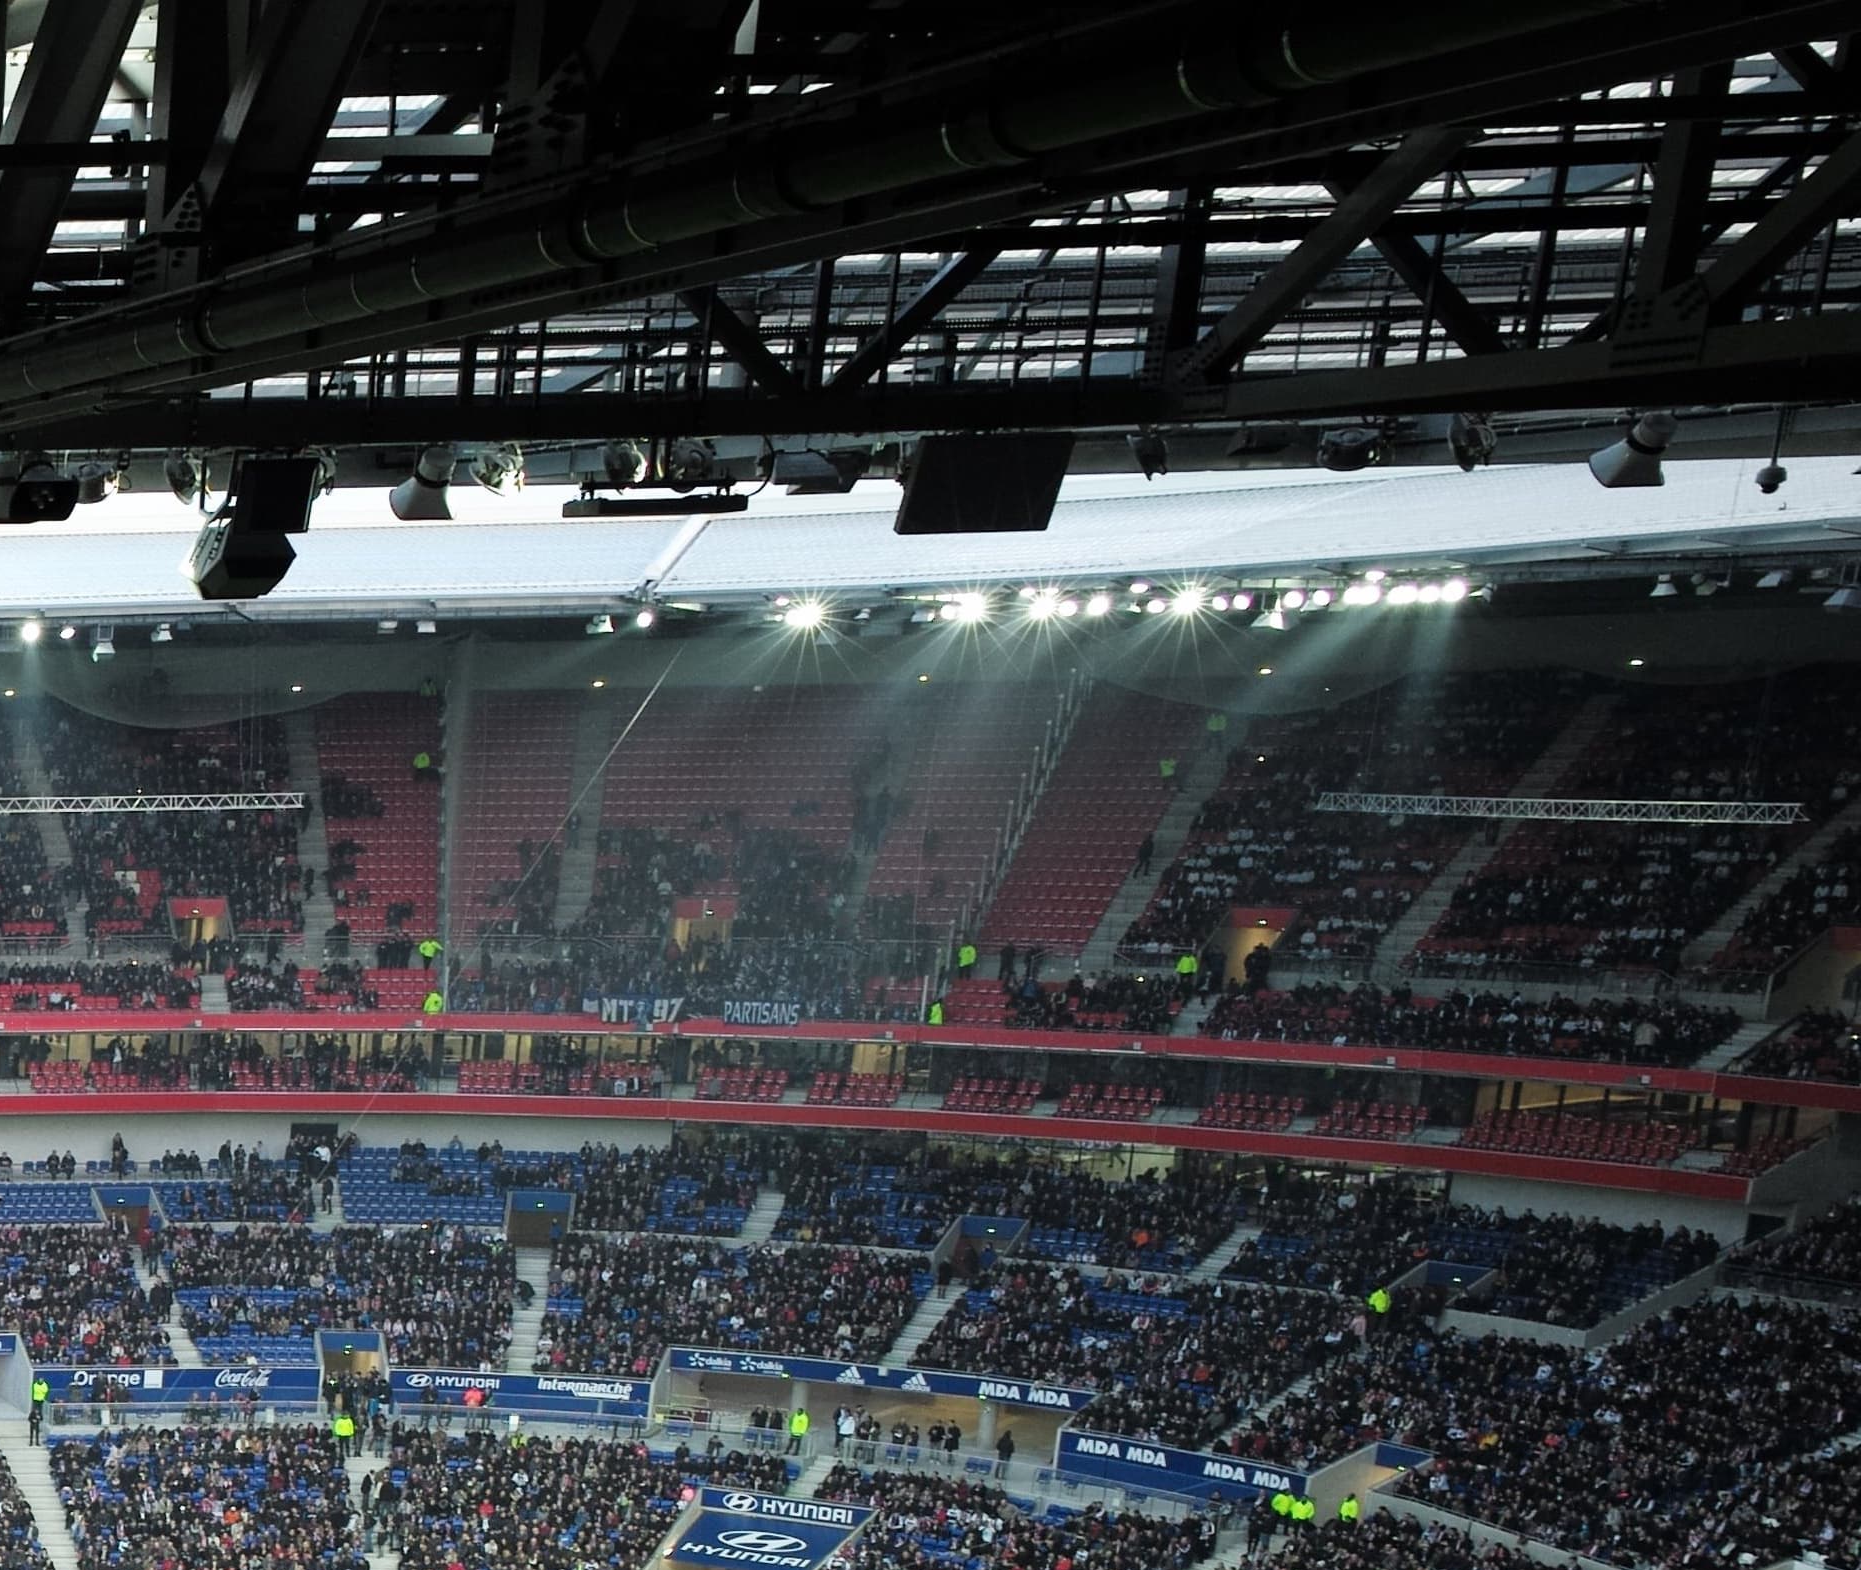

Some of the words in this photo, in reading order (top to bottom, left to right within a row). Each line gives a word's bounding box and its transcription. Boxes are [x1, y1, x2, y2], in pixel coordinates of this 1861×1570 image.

[724, 1001, 800, 1025] PARTISANS
[435, 1375, 500, 1389] HYUNDAI
[978, 1381, 1020, 1400] MDA
[1028, 1389, 1071, 1407] MDA
[1078, 1438, 1121, 1458] MDA
[1127, 1447, 1167, 1467] MDA
[1203, 1461, 1245, 1482] MDA
[1253, 1470, 1291, 1490] MDA
[762, 1498, 853, 1524] HYUNDAI
[680, 1542, 812, 1568] HYUNDAI
